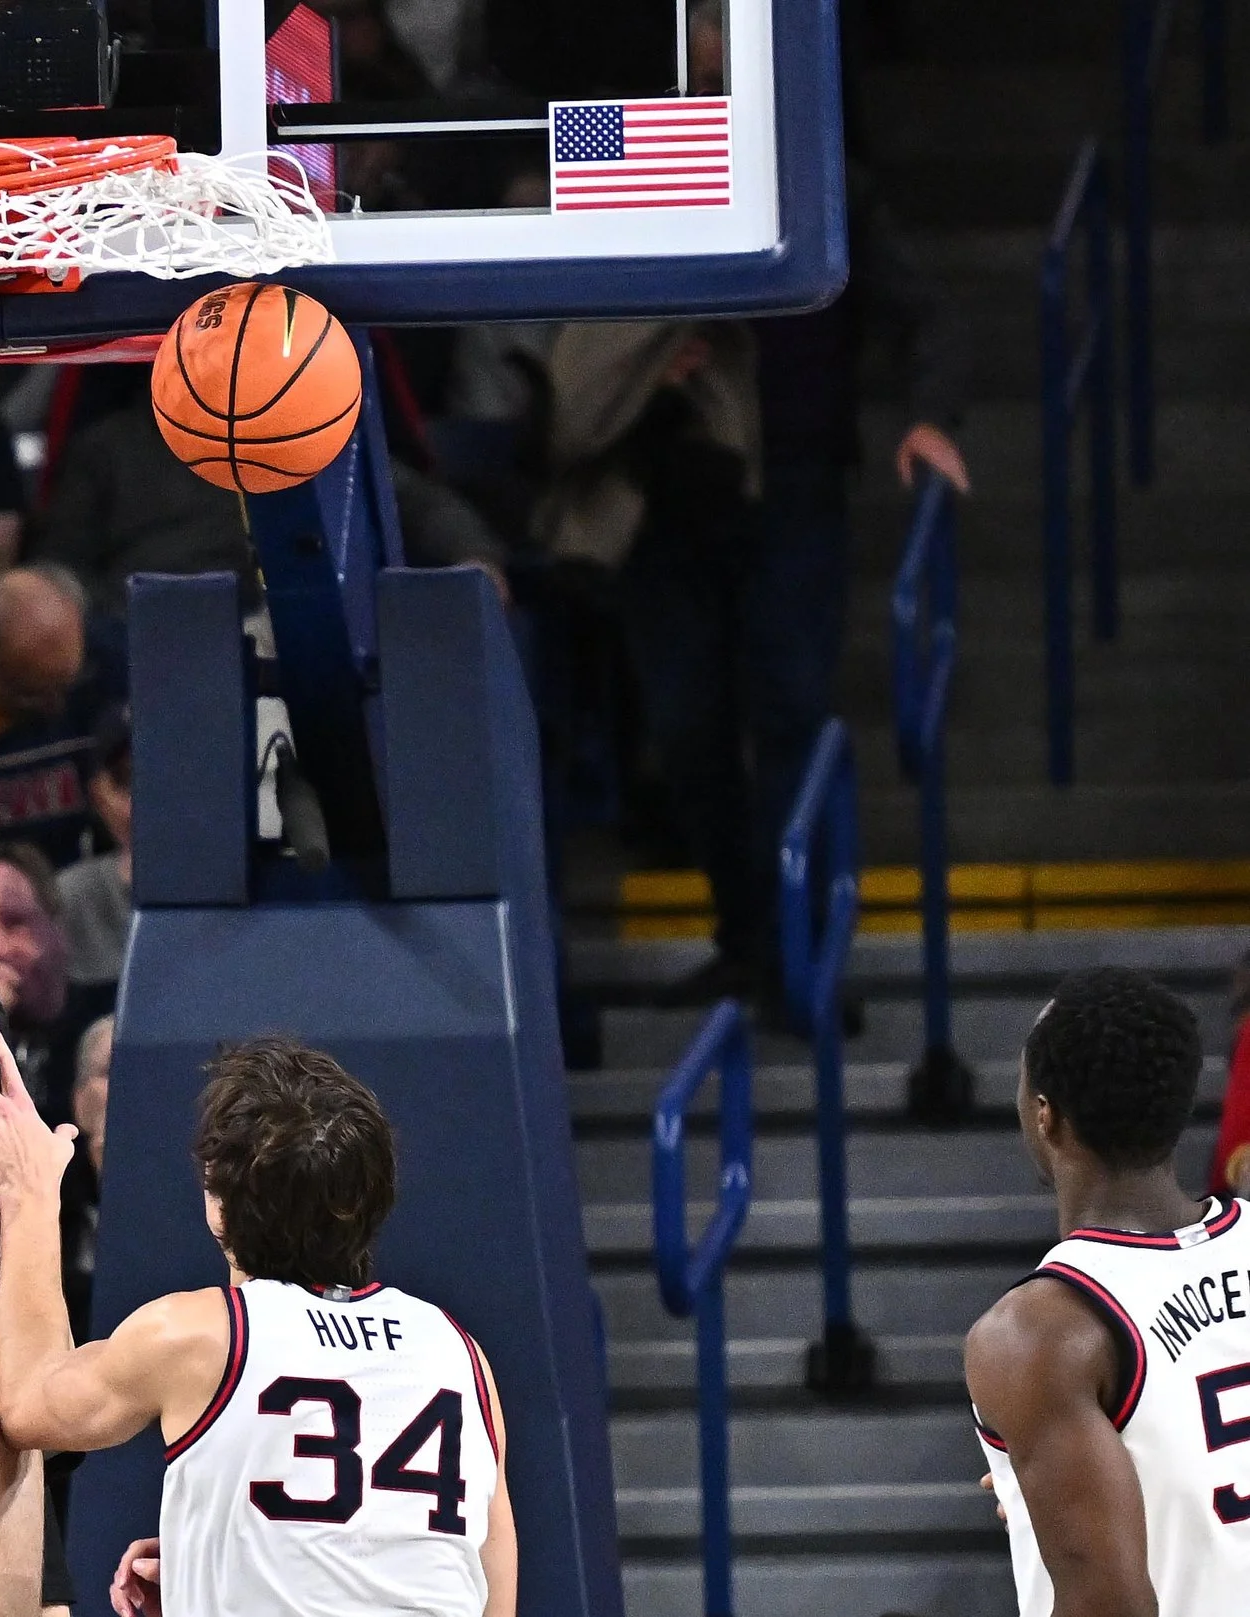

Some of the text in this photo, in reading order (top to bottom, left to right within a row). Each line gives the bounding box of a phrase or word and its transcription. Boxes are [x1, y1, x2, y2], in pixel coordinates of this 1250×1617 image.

[306, 1309, 403, 1351] HUFF
[1149, 1269, 1250, 1363] INNOCE
[249, 1376, 467, 1537] 34
